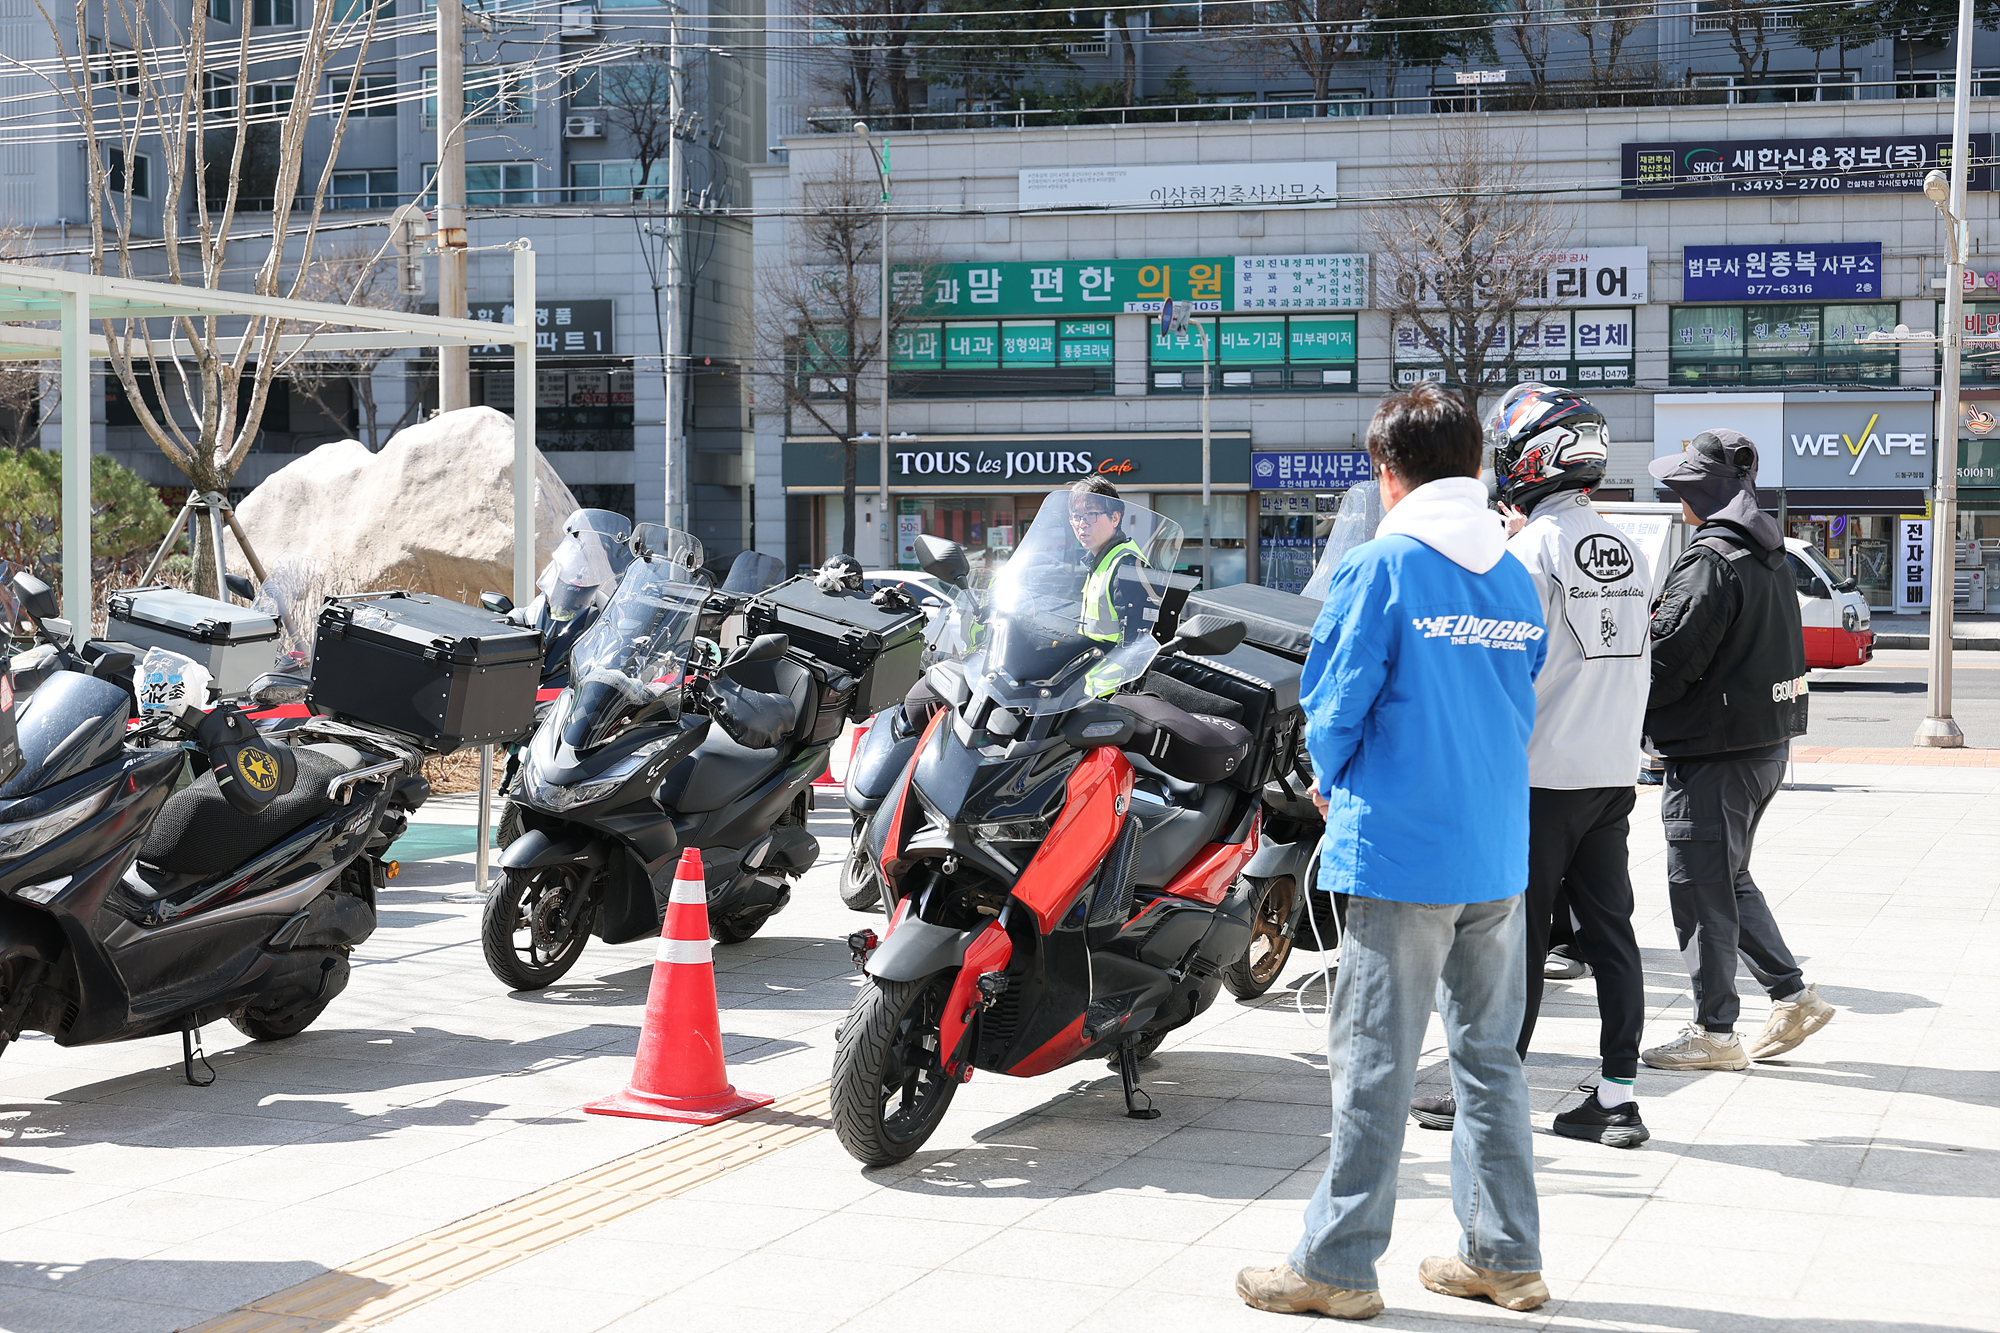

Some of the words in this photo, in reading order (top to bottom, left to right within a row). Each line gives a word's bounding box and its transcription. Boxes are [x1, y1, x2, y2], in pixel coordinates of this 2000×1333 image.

[1732, 143, 1927, 171] 새한신용정보(주)
[1639, 164, 1671, 173] 재산조사
[1693, 161, 1724, 174] SHCI
[1688, 257, 1740, 278] 법무사
[1745, 250, 1818, 279] 원종복
[1822, 255, 1875, 275] 사무소
[1031, 265, 1114, 303] 편한
[1136, 263, 1222, 300] 의원
[1747, 284, 1813, 295] 977-6316
[1855, 282, 1873, 293] 2층
[1155, 333, 1211, 350] 피부과
[1221, 332, 1283, 349] 비뇨기과
[1291, 331, 1352, 346] 피부레이저
[1517, 324, 1567, 349] 전문
[1578, 323, 1628, 348] 업체
[1679, 325, 1738, 344] 법무사
[1753, 322, 1814, 341] 원종복
[950, 335, 994, 356] 내과
[1003, 336, 1053, 354] 정형외과
[1063, 340, 1110, 358] 통증크리닉
[895, 451, 971, 475] TOUS
[975, 450, 1001, 473] les
[1004, 451, 1093, 479] JOURS
[1097, 458, 1133, 476] Café
[1580, 538, 1629, 571] Arai
[1906, 523, 1925, 604] 전자담배
[1450, 636, 1468, 646] THE
